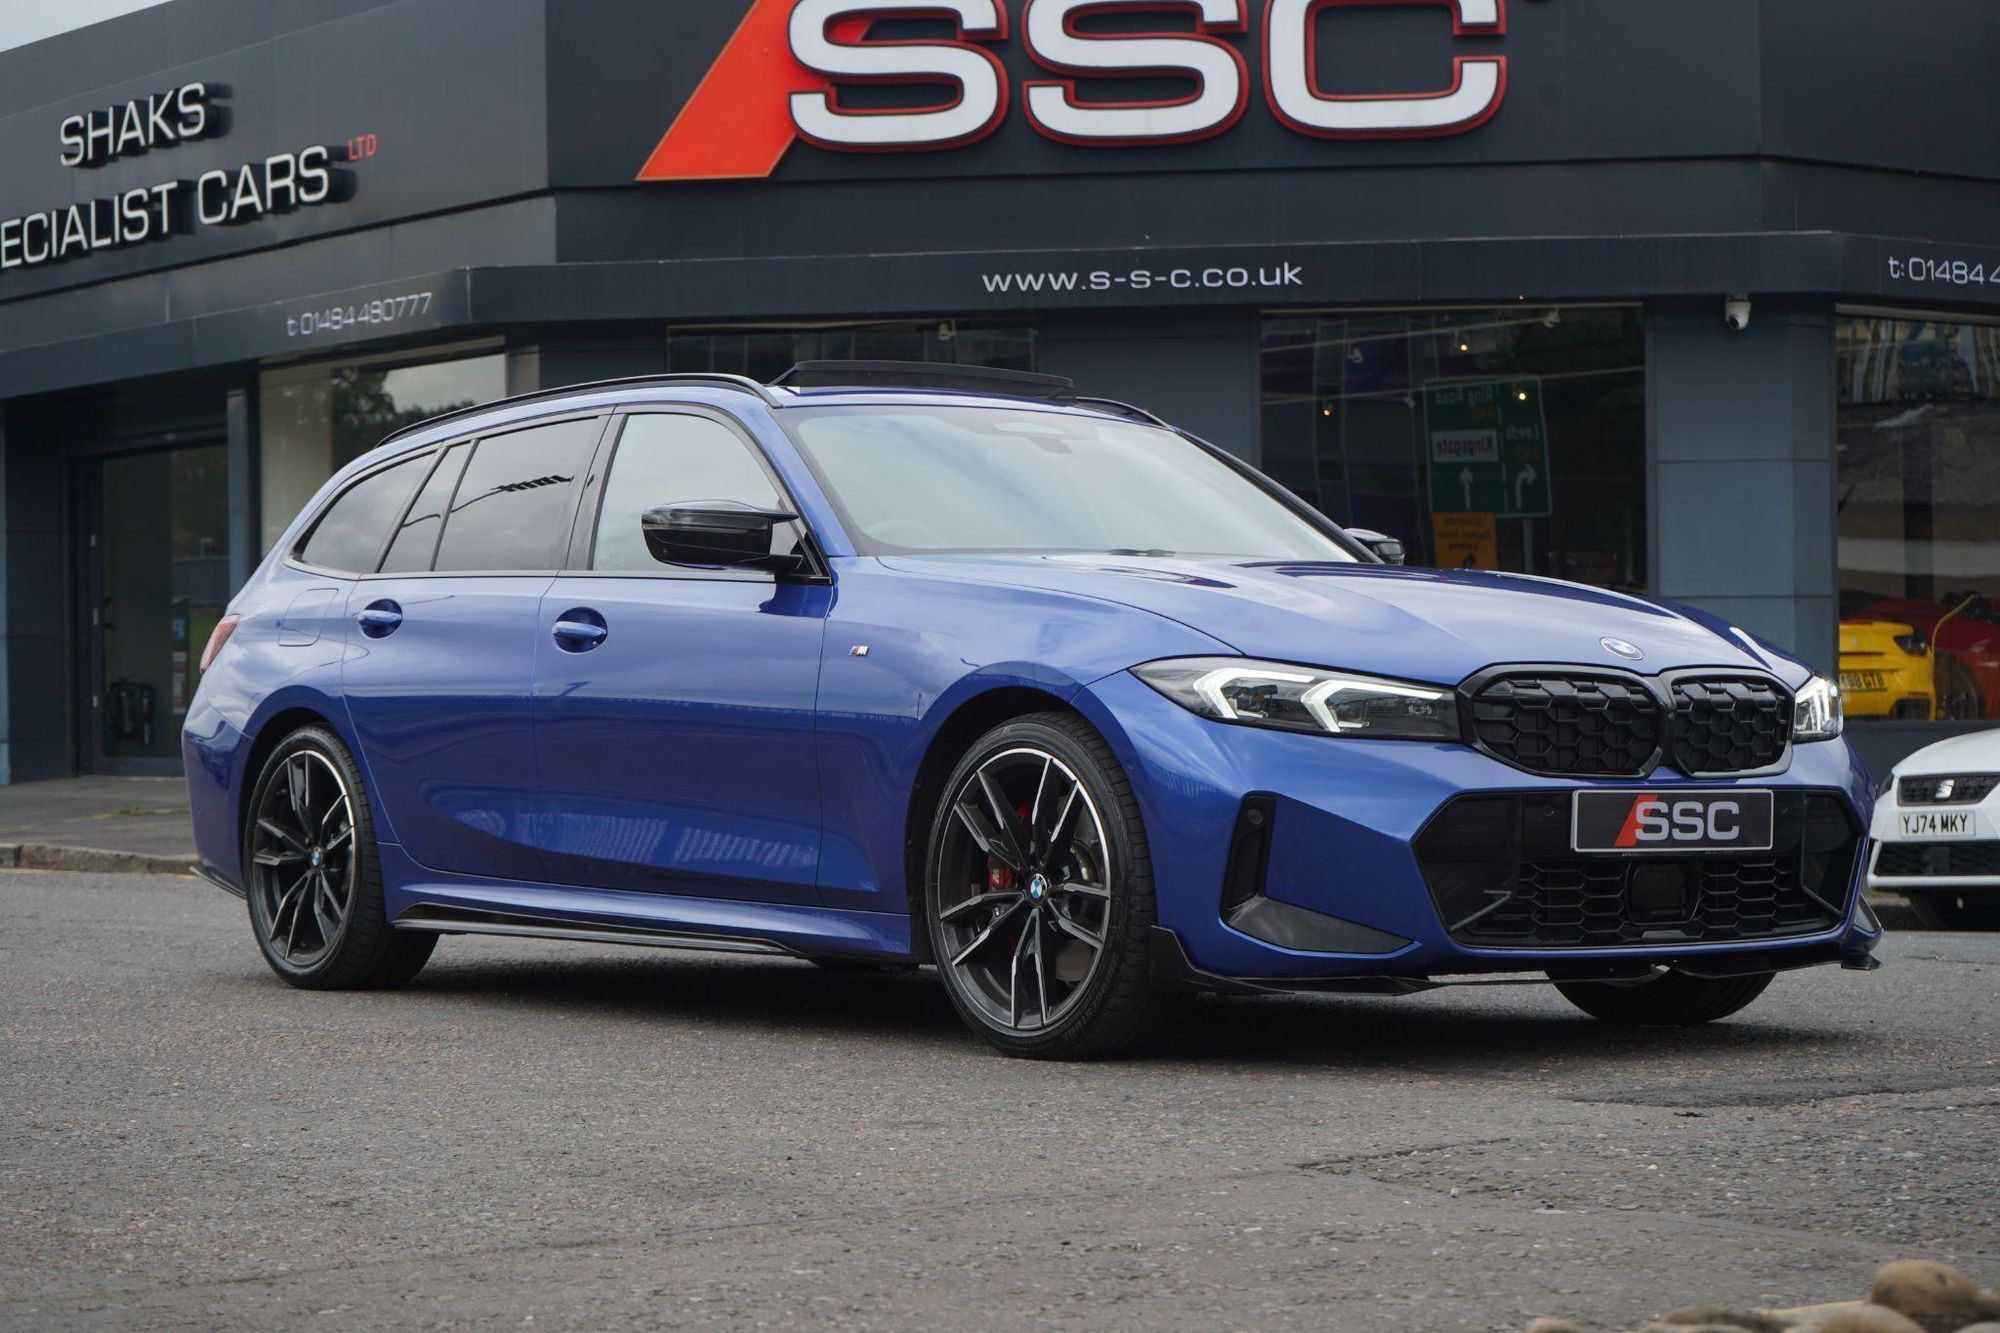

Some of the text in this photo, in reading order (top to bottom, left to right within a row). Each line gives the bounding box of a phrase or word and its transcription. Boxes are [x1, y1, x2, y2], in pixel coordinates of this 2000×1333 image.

[788, 0, 1508, 148] SSC
[60, 82, 206, 167] SHAKS
[198, 145, 329, 225] CARS
[348, 133, 377, 161] LTD
[982, 262, 1303, 292] www.s-s-c.co.uk
[1887, 255, 1985, 285] t:01484
[357, 292, 432, 324] 480777
[1635, 801, 1740, 841] SSC
[1903, 814, 1968, 834] YJ74 MKY
